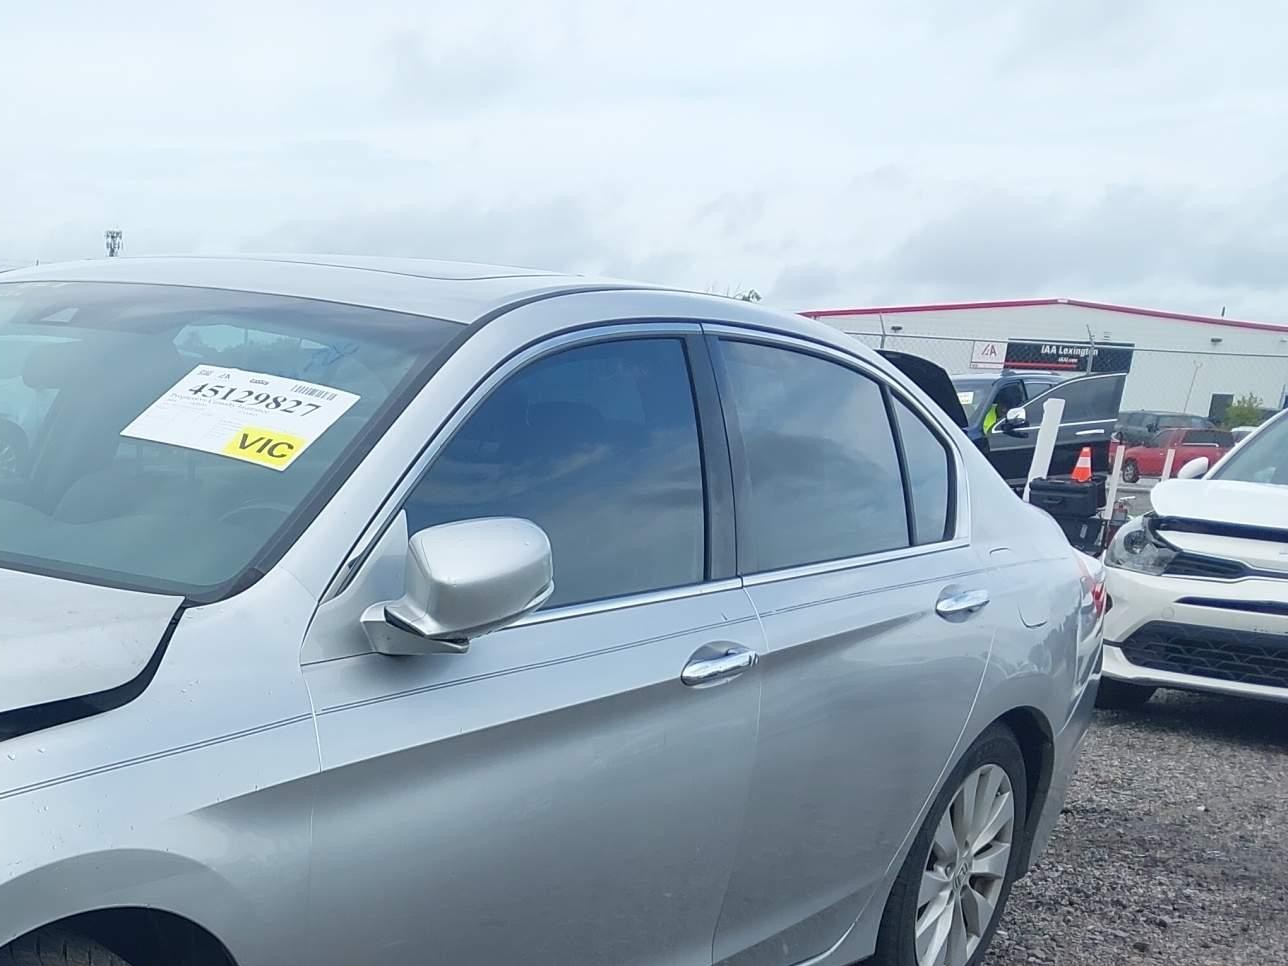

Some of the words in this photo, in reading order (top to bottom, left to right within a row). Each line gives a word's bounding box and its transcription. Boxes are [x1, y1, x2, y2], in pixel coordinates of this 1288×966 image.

[1041, 344, 1057, 355] IAA
[188, 382, 322, 417] 45129827
[239, 433, 294, 458] VIC
